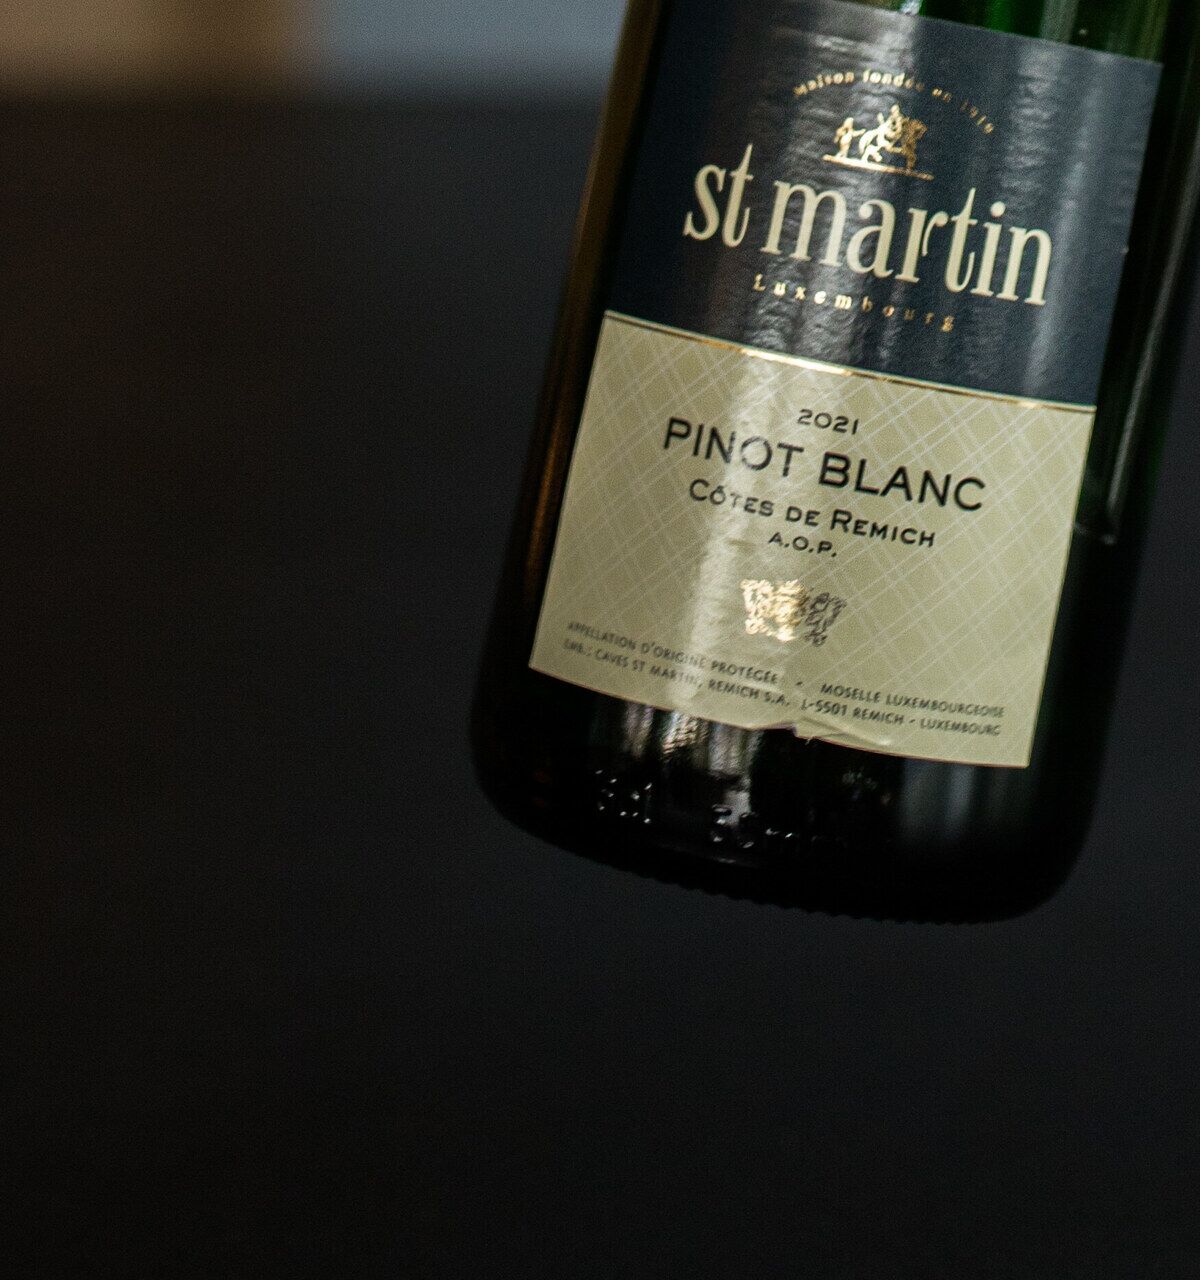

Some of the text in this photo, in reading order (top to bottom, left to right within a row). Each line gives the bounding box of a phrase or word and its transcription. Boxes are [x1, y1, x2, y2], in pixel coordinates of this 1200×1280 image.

[683, 143, 1053, 306] st martin
[753, 272, 955, 333] Luxembourg
[797, 408, 860, 435] 2021
[663, 417, 986, 512] PINOT BLANC
[786, 505, 820, 527] DE
[769, 532, 838, 558] A.O.P.
[595, 648, 629, 669] CAVES
[632, 658, 646, 673] ST
[708, 678, 760, 700] REMICH
[801, 698, 848, 716] L-5501
[853, 706, 904, 725] REMICH
[920, 717, 1002, 737] LUXEMBOURG
[820, 683, 881, 704] MOSELLE
[886, 693, 1005, 718] LUXEMBOURGEOISE
